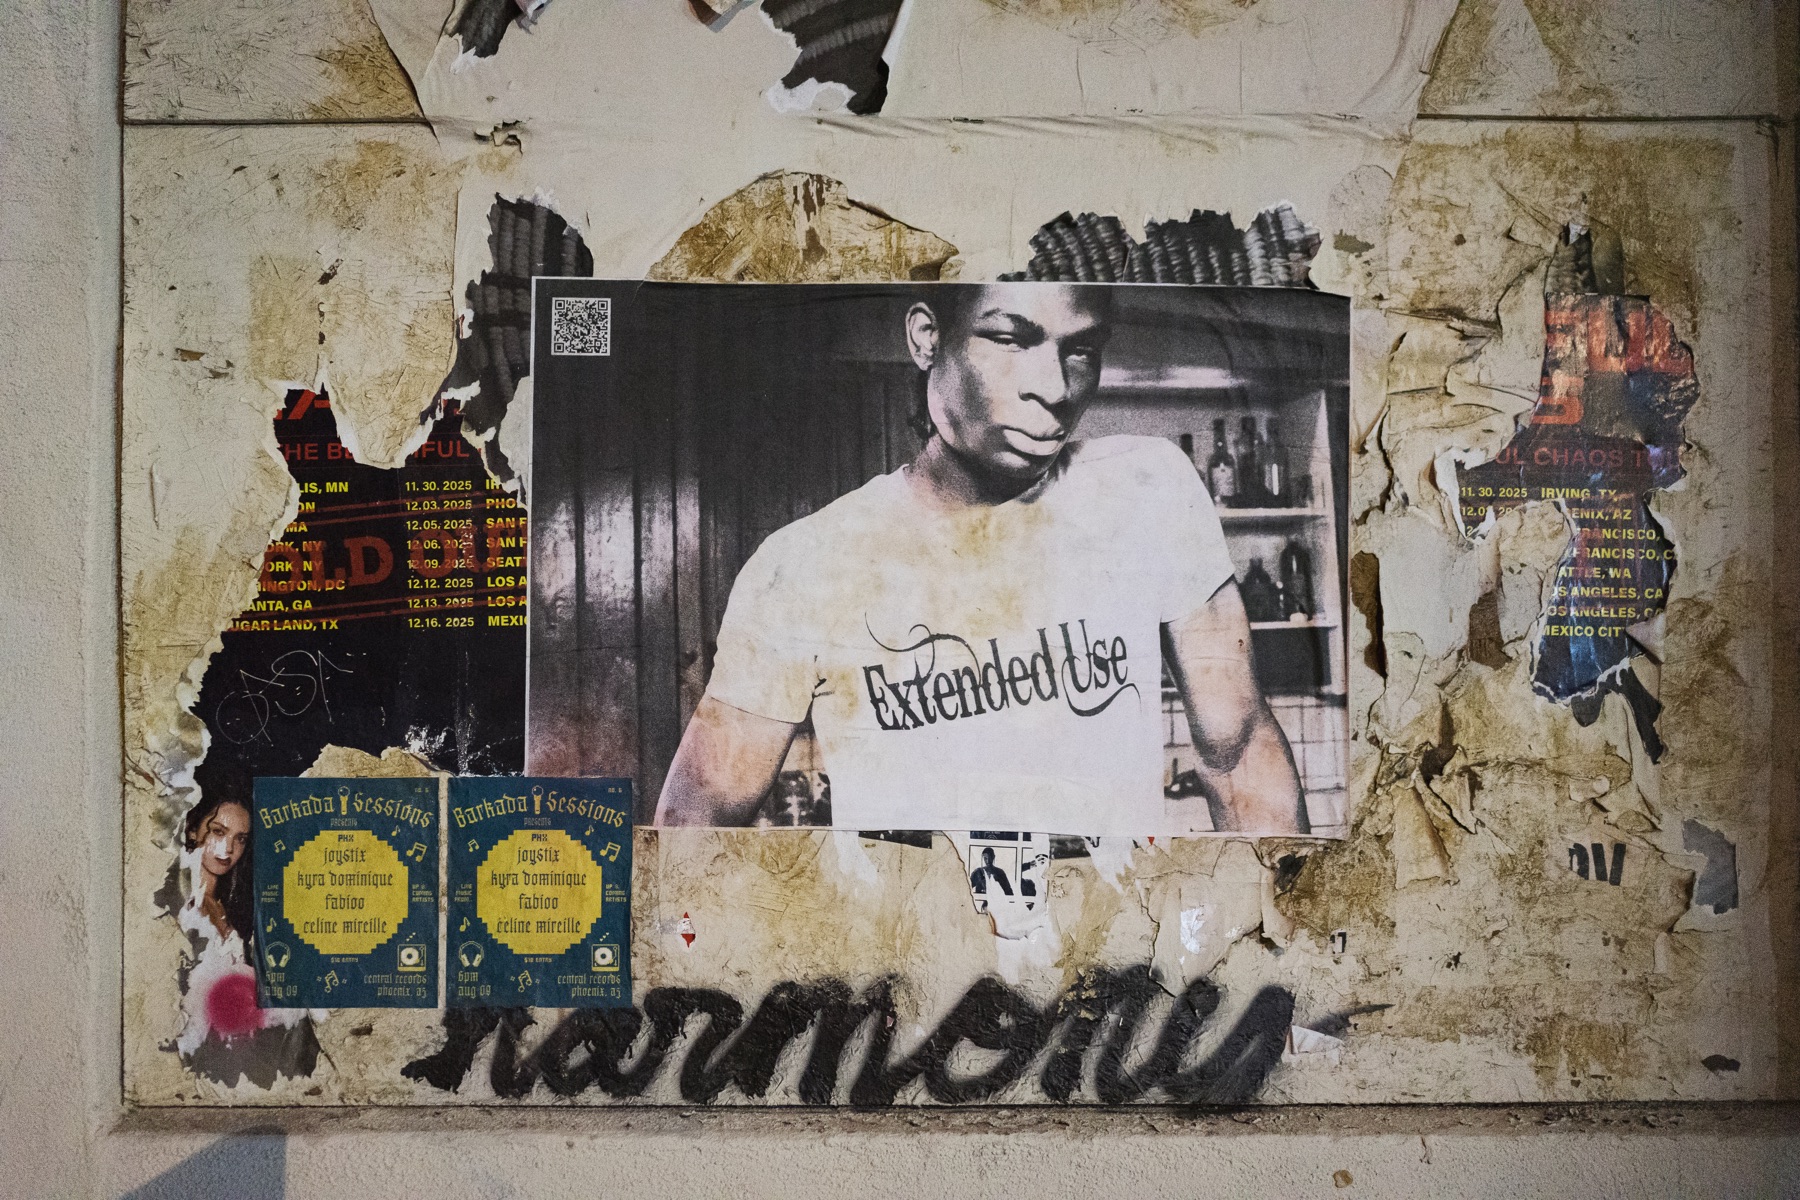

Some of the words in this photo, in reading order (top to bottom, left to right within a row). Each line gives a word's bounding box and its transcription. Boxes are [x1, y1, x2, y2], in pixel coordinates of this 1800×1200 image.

[1533, 448, 1623, 467] CHAOS
[326, 482, 349, 492] MN
[1612, 509, 1632, 520] AZ
[286, 522, 308, 532] MA
[486, 518, 515, 528] SAN
[303, 540, 323, 551] NY
[486, 538, 515, 548] SAN
[303, 561, 323, 571] NY
[1609, 567, 1632, 579] WA
[325, 580, 346, 591] DC
[487, 576, 515, 587] LOS
[1571, 587, 1641, 599] ANGELES,
[1644, 588, 1664, 599] CA
[292, 600, 313, 610] GA
[487, 596, 515, 607] LOS
[1570, 606, 1641, 619] ANGELES,
[273, 620, 317, 631] LAND,
[321, 620, 339, 630] TX
[862, 615, 1059, 731] Extended
[1059, 618, 1142, 717] Use
[259, 793, 335, 829] Barkada
[352, 791, 434, 828] Sessions
[452, 793, 528, 828] Barkada
[546, 790, 628, 828] Sessions
[338, 834, 354, 842] PHX
[531, 833, 548, 842] PHX
[323, 847, 367, 866] joystix
[517, 847, 560, 865] joystix
[297, 871, 325, 889] kyra
[329, 870, 393, 888] dominique
[491, 870, 519, 889] kyra
[522, 870, 587, 888] dominique
[325, 893, 365, 910] fabioo
[518, 893, 559, 910] fabioo
[303, 917, 337, 934] celine
[343, 917, 387, 934] mireille
[536, 917, 581, 934] mireille
[363, 973, 392, 984] central
[395, 973, 427, 984] records
[457, 971, 479, 983] 6pm
[557, 973, 586, 984] central
[589, 973, 621, 984] records
[286, 985, 298, 996] 09
[458, 985, 476, 999] aug
[479, 985, 491, 996] 09
